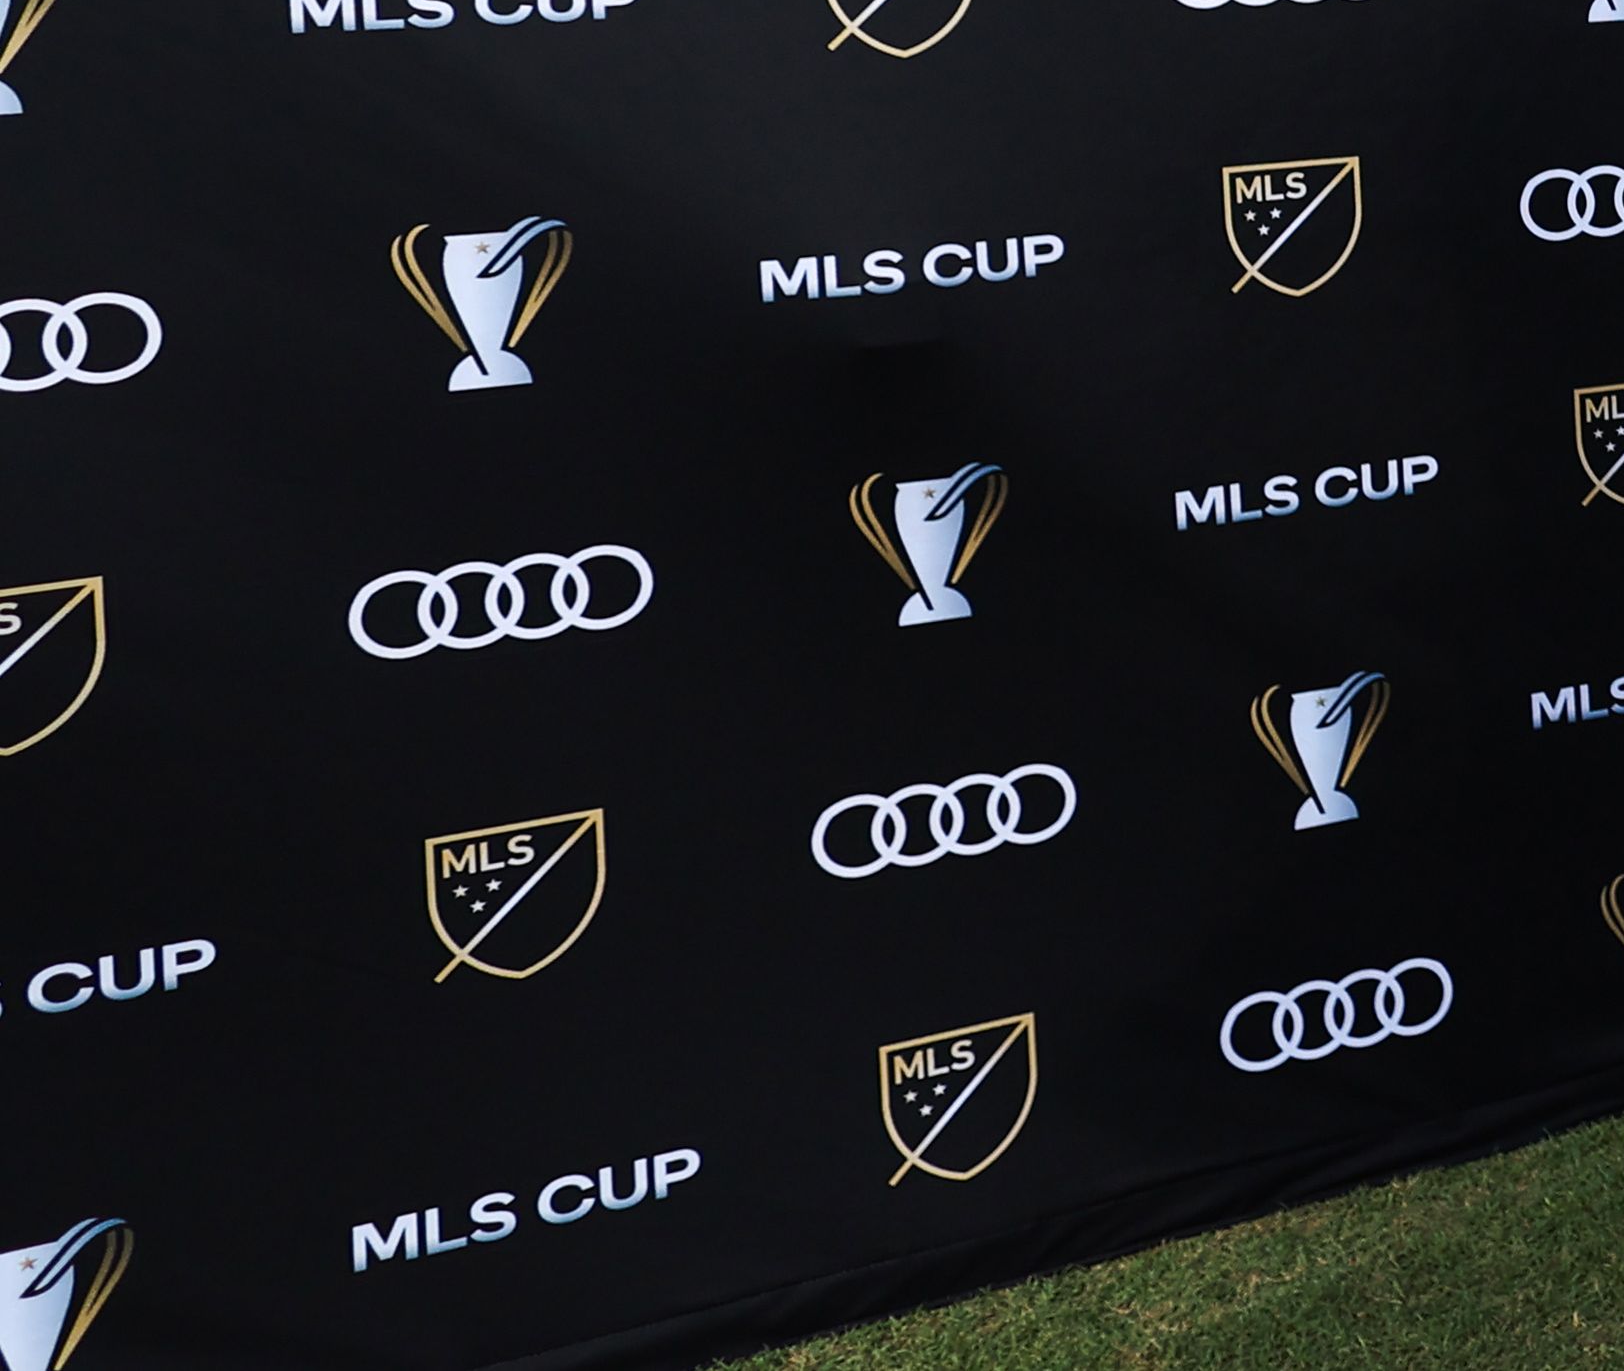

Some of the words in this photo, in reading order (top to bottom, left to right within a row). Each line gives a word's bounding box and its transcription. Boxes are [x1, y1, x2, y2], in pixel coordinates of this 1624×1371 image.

[1235, 171, 1307, 204] MLS
[759, 249, 906, 302] MLS
[922, 234, 1065, 287] CUP
[1174, 475, 1300, 530] MLS
[1314, 455, 1439, 507] CUP
[441, 834, 535, 879] MLS
[27, 939, 217, 1013] CUP
[893, 1039, 976, 1085] MLS
[352, 1192, 517, 1272] MLS
[537, 1148, 701, 1224] CUP
